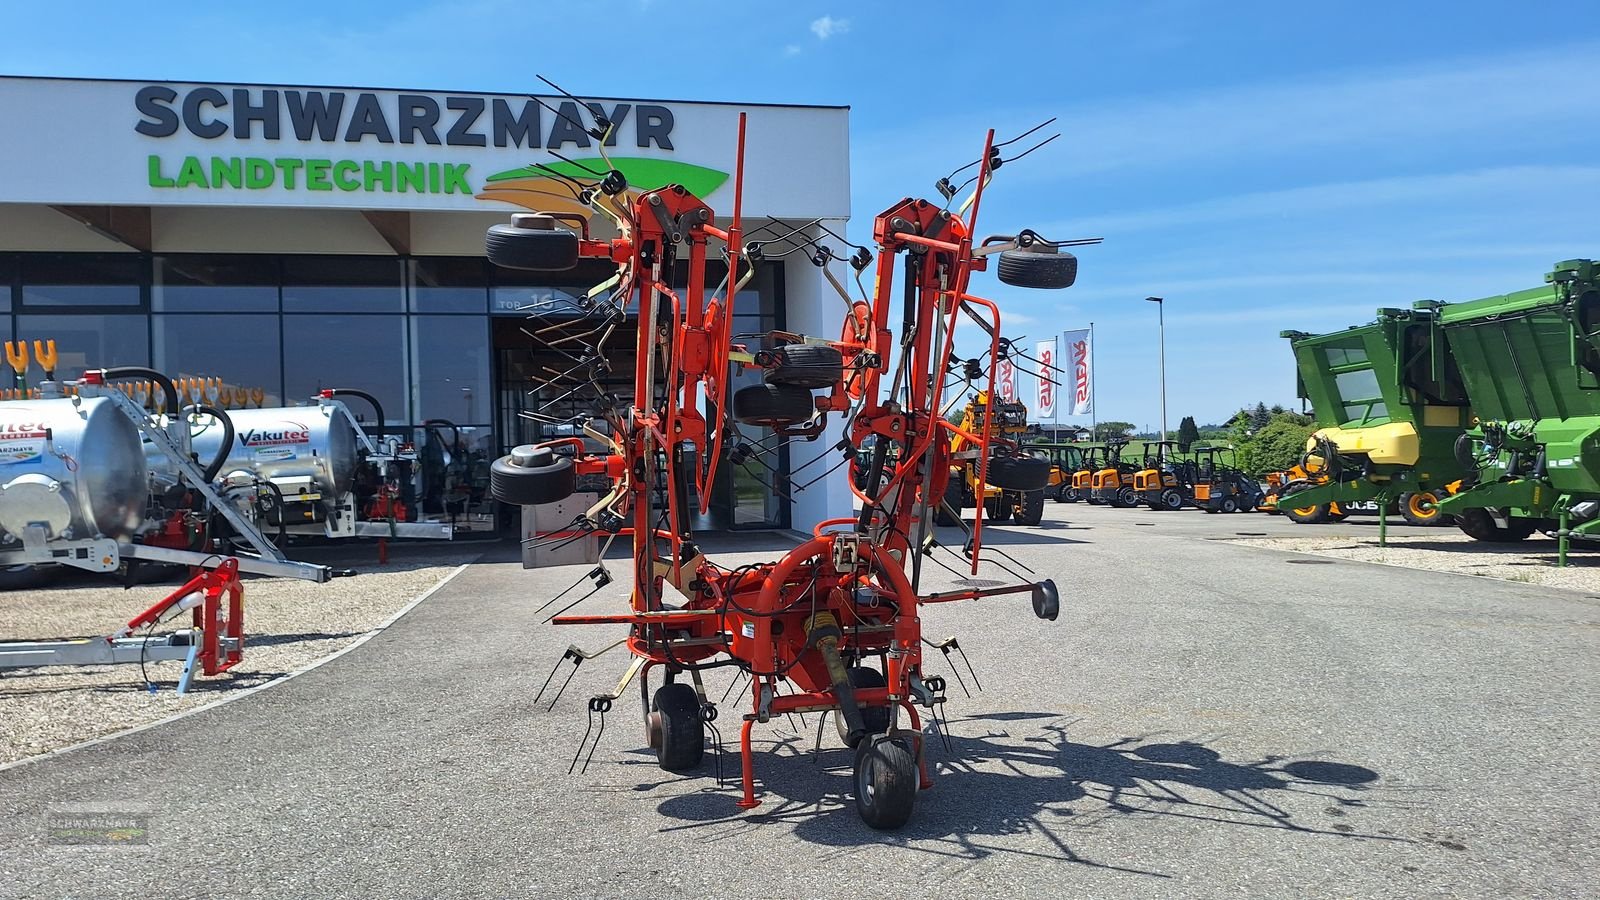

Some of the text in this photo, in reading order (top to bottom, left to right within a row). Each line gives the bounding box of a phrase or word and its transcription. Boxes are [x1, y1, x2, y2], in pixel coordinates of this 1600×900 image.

[135, 86, 674, 150] SCHWARZMAYR
[148, 155, 472, 194] LANDTECHNIK
[500, 294, 554, 310] TOR 16
[238, 428, 310, 446] Vakutec
[1345, 501, 1378, 509] JCB
